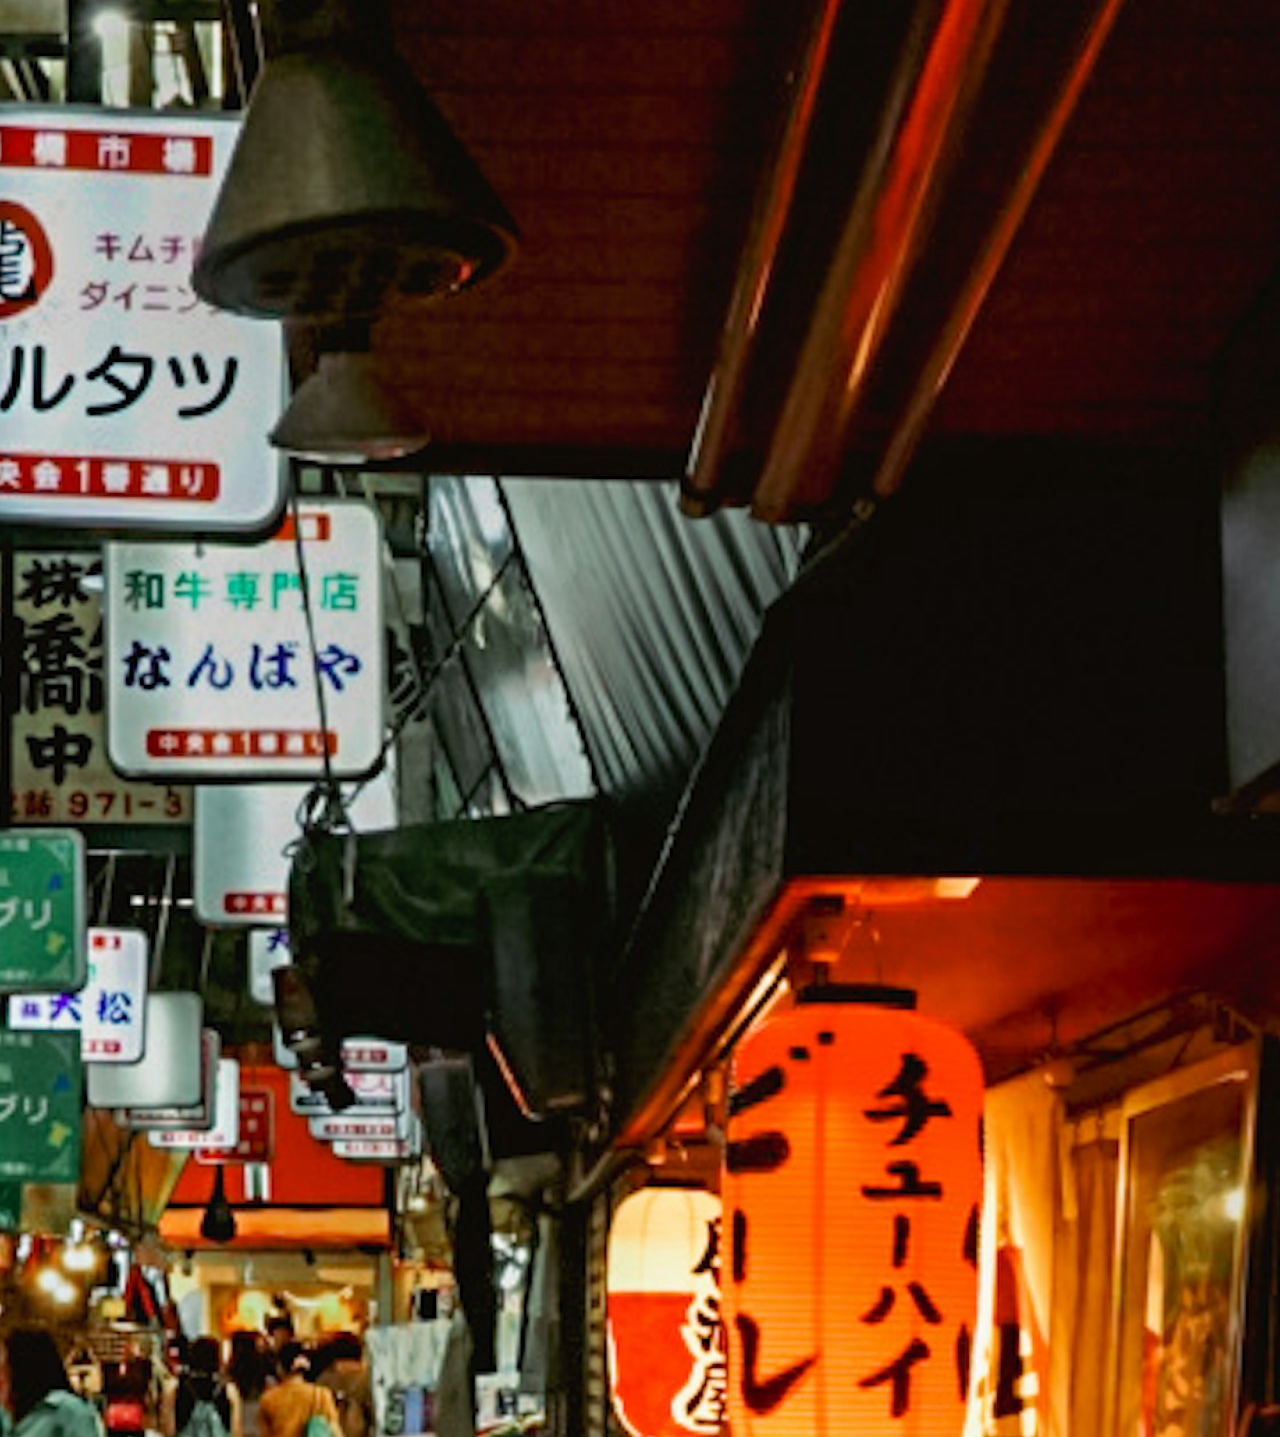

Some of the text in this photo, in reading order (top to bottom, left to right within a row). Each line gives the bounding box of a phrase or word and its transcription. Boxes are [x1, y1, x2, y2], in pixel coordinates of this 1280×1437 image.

[96, 233, 201, 264] キムチ
[79, 280, 219, 314] ダイニン
[18, 555, 103, 608] 株
[124, 569, 360, 611] 和牛専門店
[122, 641, 363, 691] なんばや
[860, 1052, 952, 1420] チューハイ
